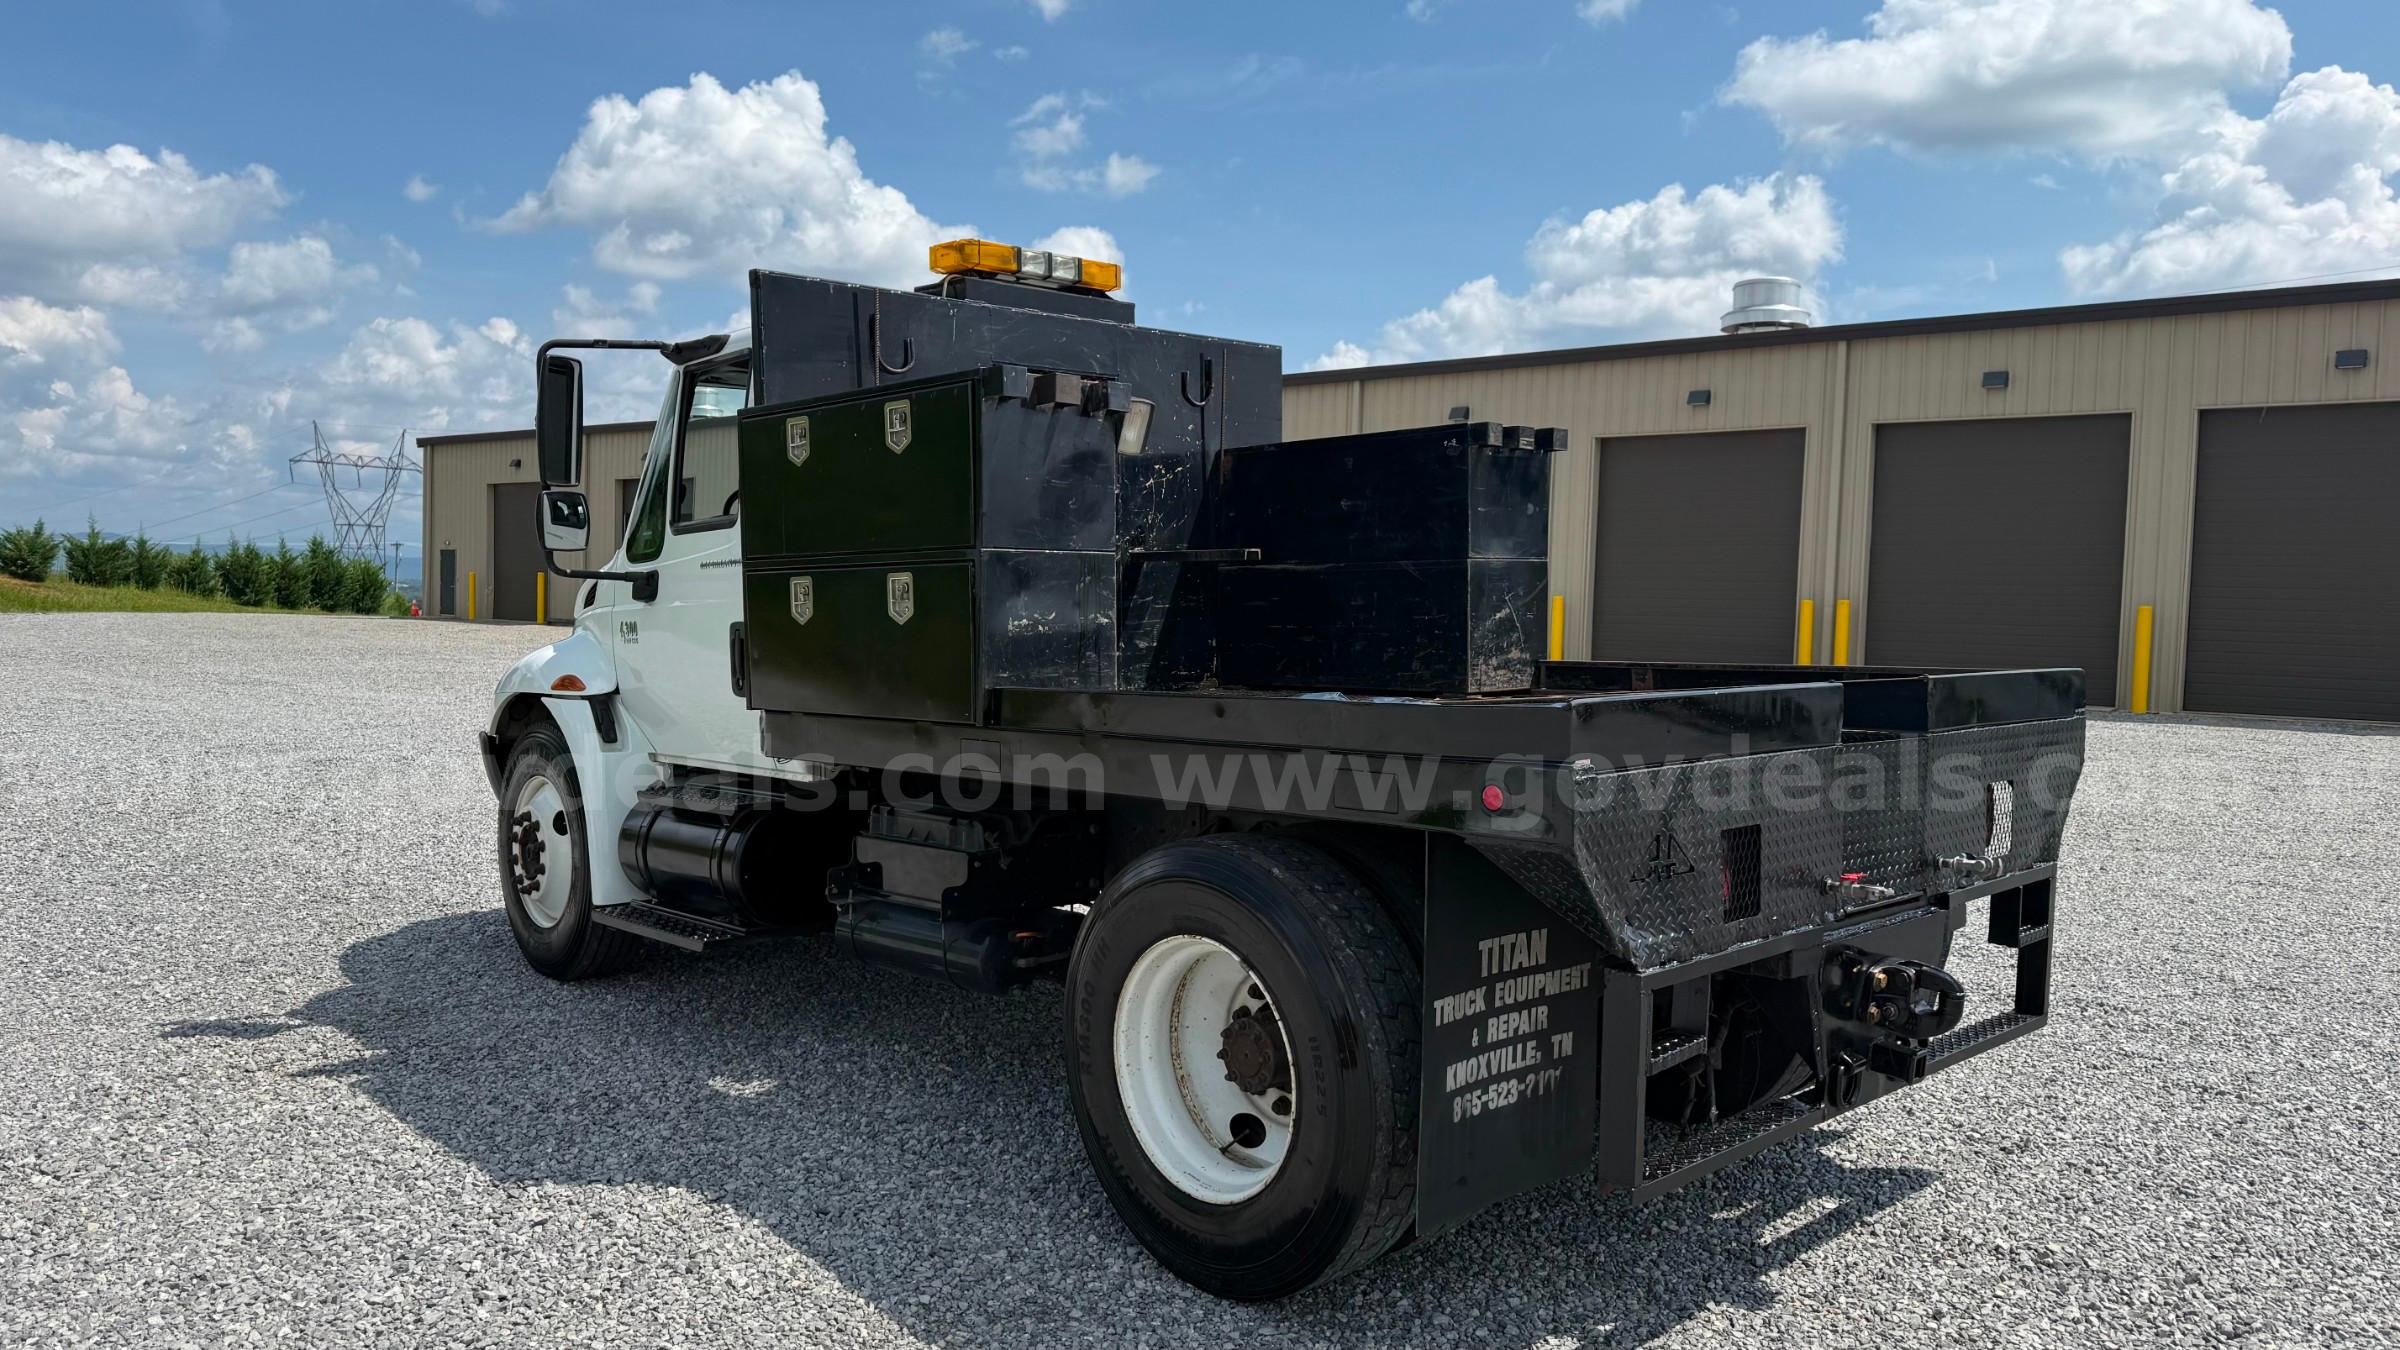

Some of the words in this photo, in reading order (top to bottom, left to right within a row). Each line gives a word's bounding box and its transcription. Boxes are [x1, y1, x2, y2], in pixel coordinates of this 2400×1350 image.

[1478, 928, 1548, 978] TITAN
[1433, 986, 1487, 1027] TRUCK
[1494, 962, 1592, 1009] EQUIPMENT
[1471, 1027, 1479, 1048] &
[1487, 1005, 1549, 1044] REPAIR
[1446, 1039, 1542, 1092] KNOXVILLE,
[1552, 1031, 1574, 1060] TN
